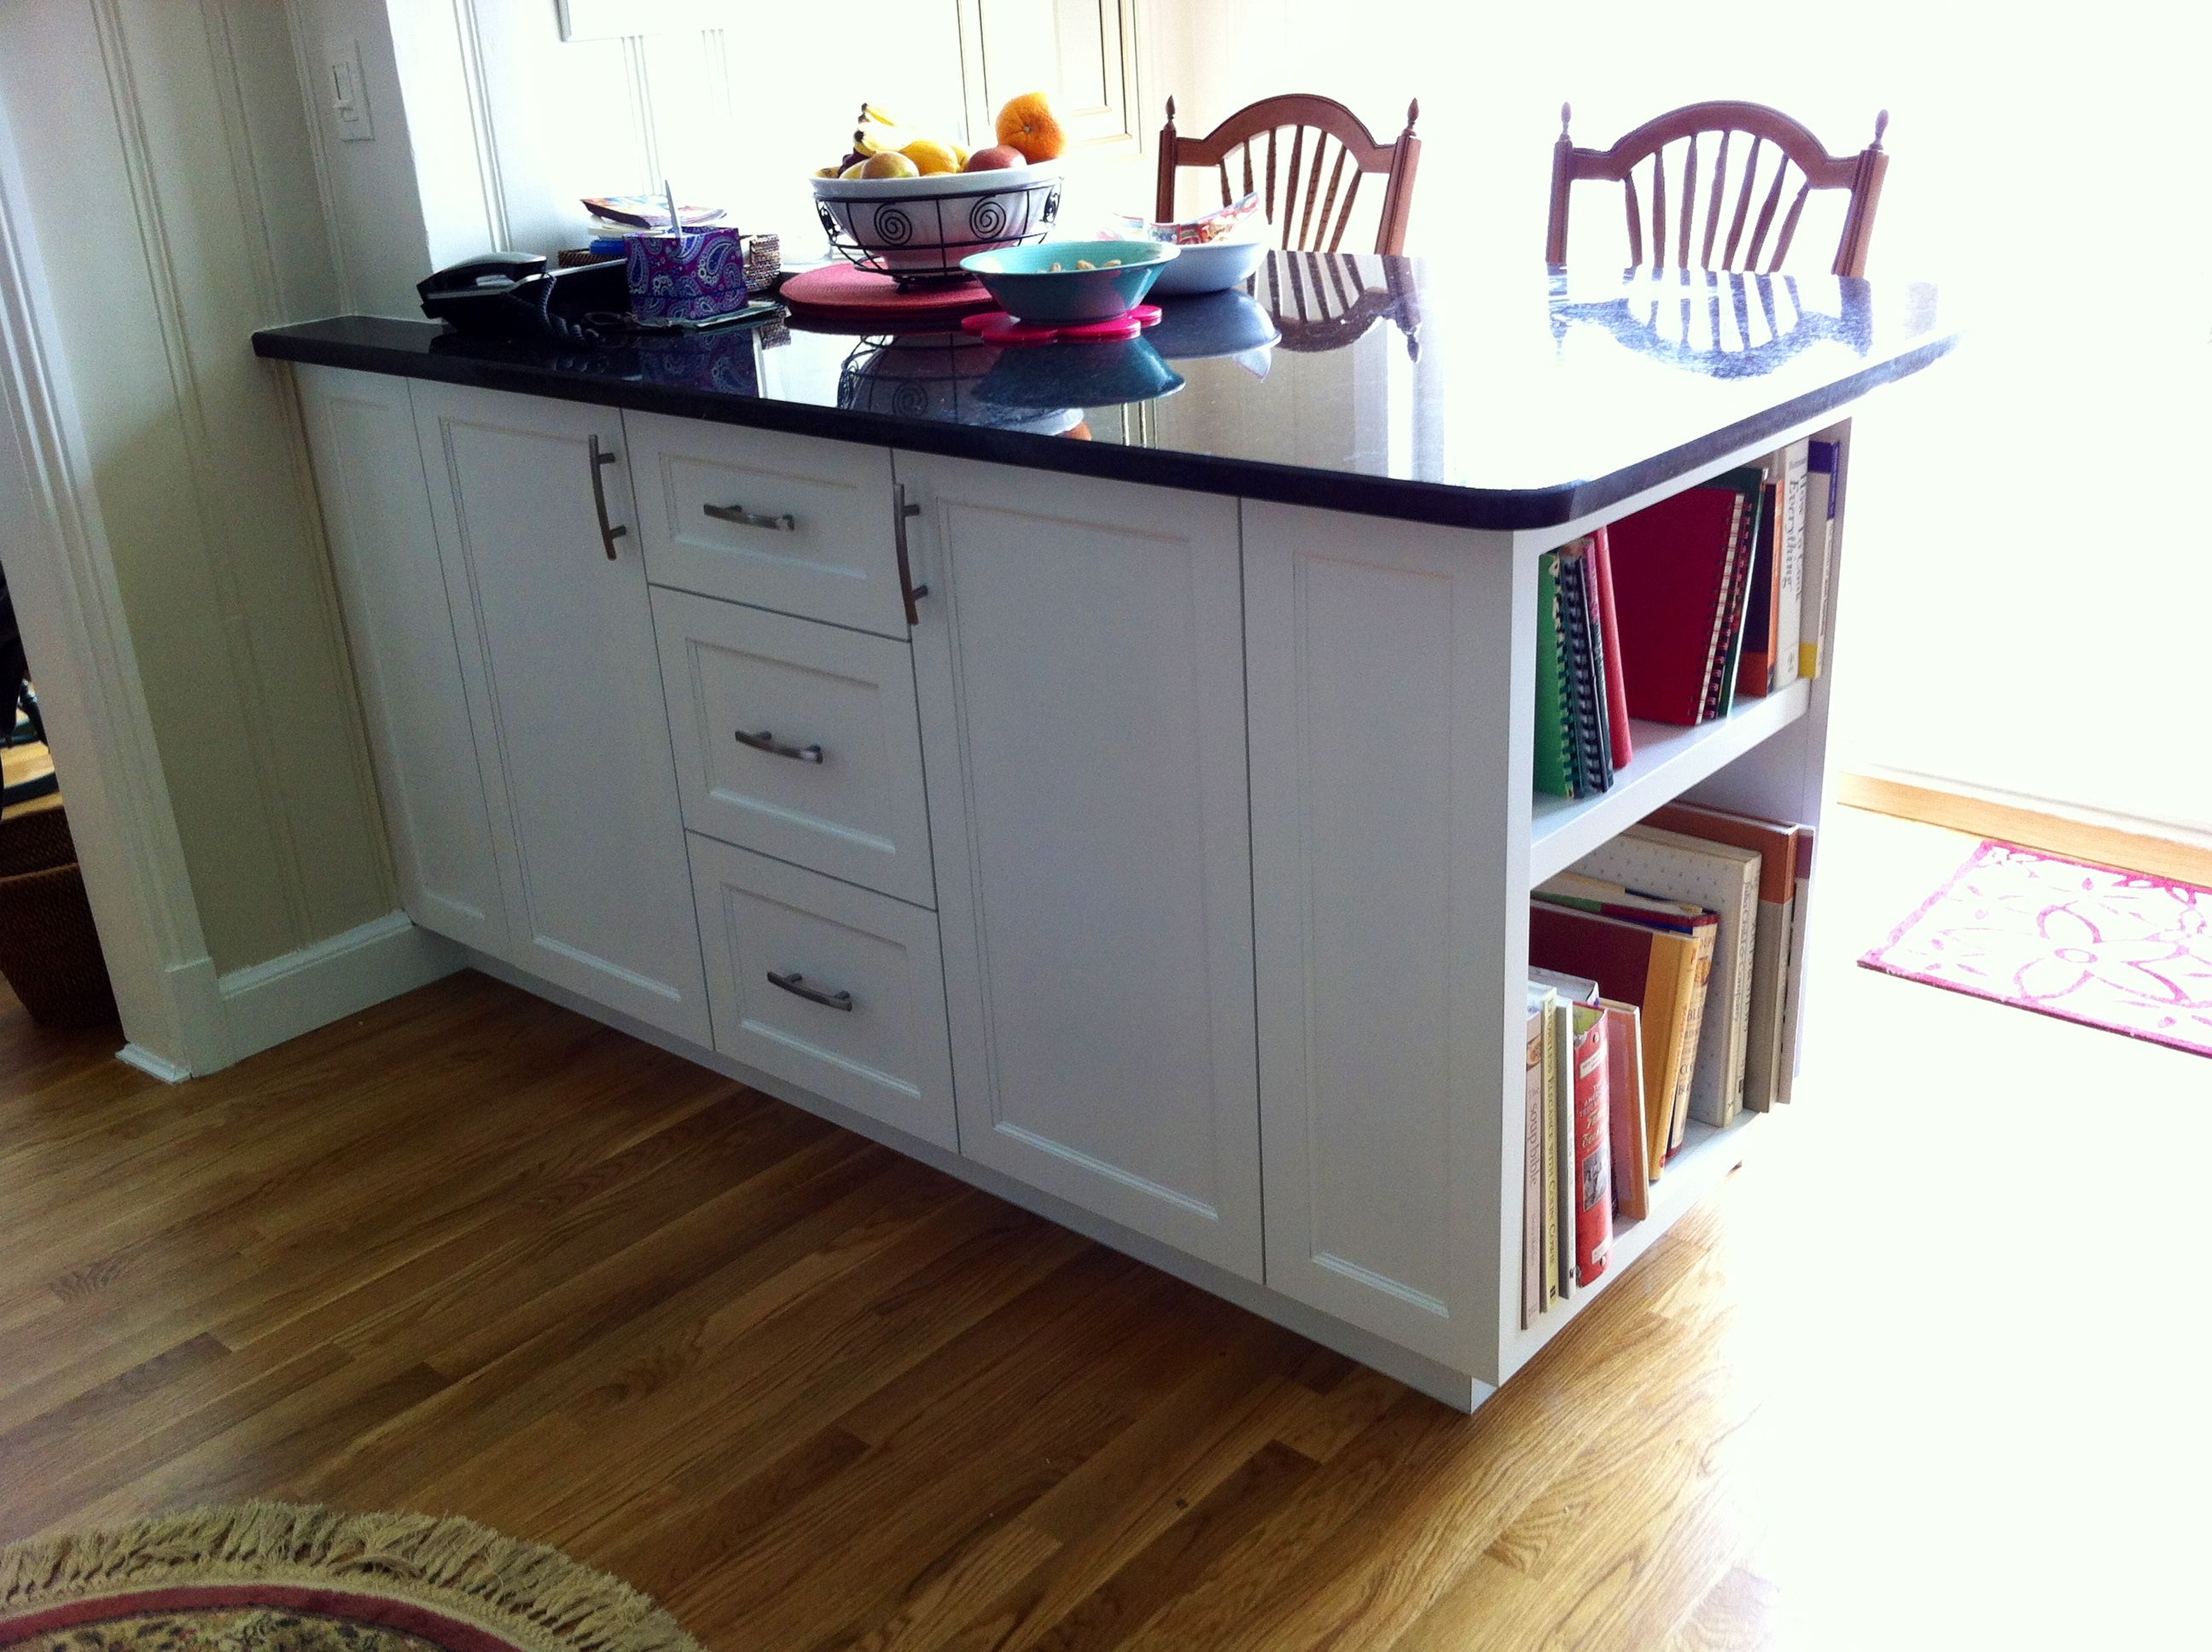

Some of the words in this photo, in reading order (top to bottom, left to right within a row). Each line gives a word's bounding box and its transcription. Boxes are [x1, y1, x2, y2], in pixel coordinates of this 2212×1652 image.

[1783, 480, 1798, 591] Everything
[1528, 1102, 1538, 1143] soup
[1529, 1143, 1540, 1188] bible
